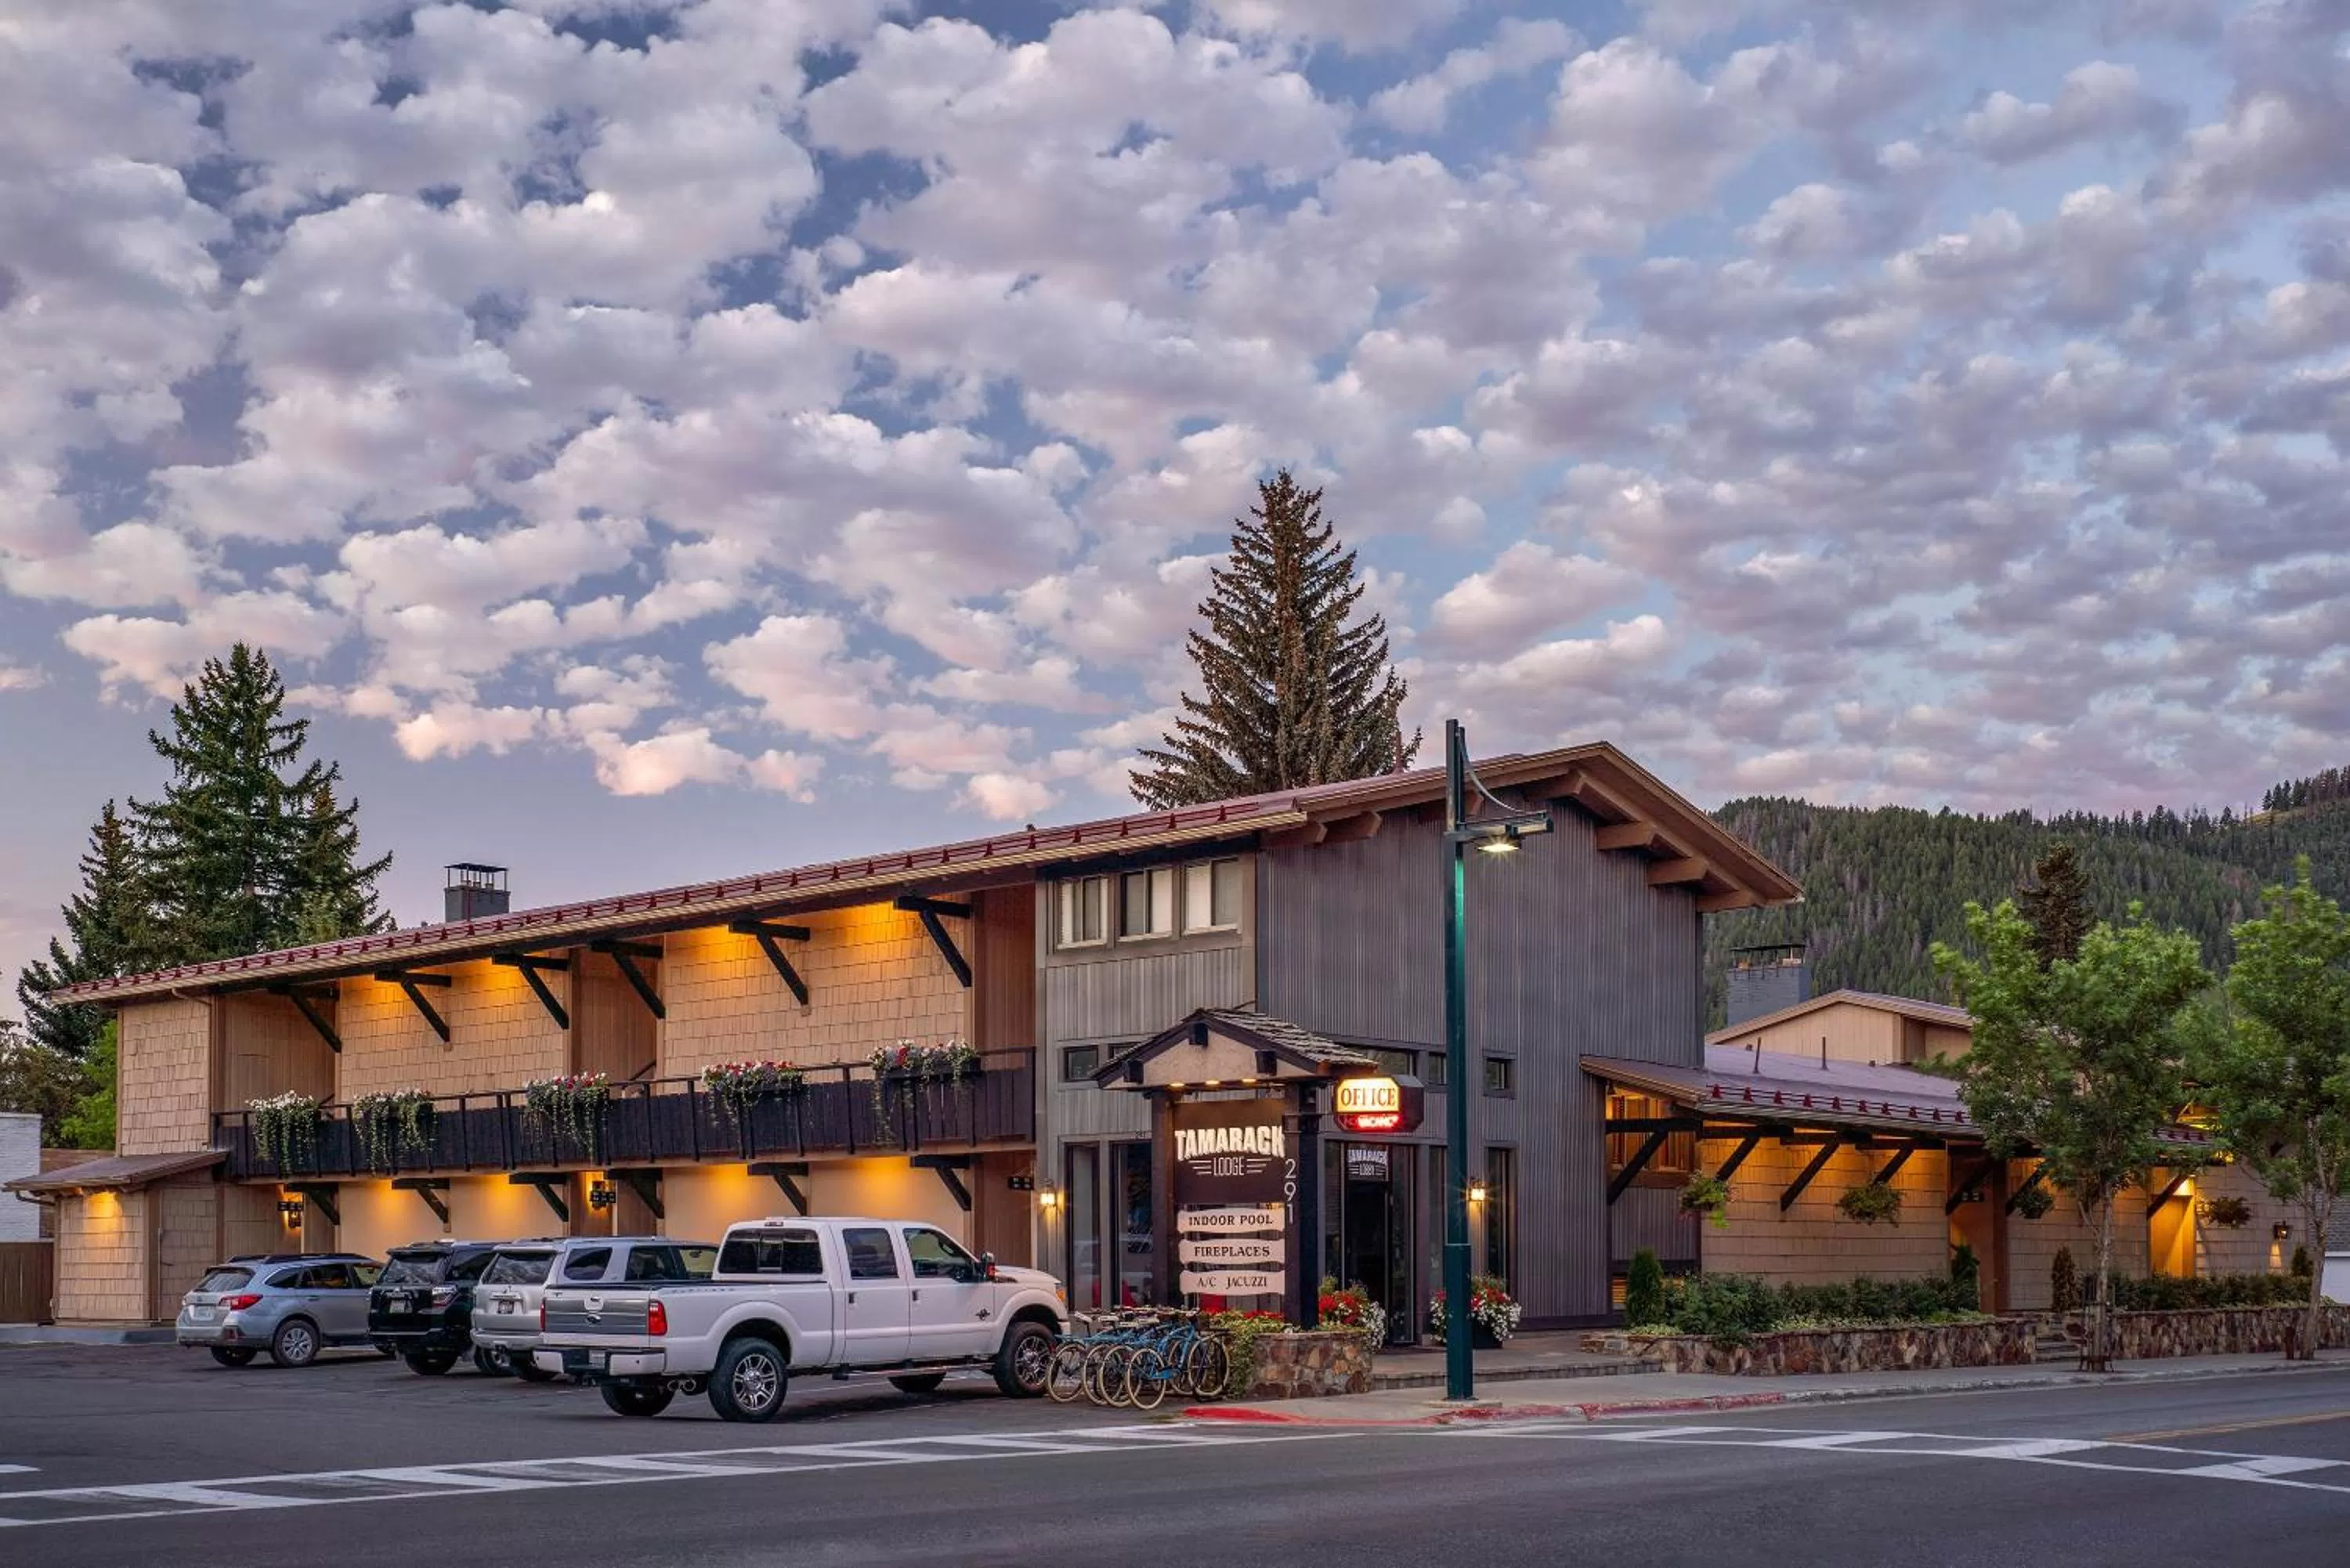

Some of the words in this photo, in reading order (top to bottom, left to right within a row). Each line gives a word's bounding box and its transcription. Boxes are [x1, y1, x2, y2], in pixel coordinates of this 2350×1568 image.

[1174, 1125, 1285, 1162] TAMARACK
[1213, 1157, 1245, 1176] LODGE
[1284, 1158, 1296, 1223] 291
[1188, 1216, 1235, 1226] INDOOR
[1240, 1215, 1273, 1225] POOL
[1194, 1246, 1271, 1257] FIREPLACES
[1197, 1277, 1217, 1288] A/C
[1226, 1276, 1267, 1289] JACUZZI
